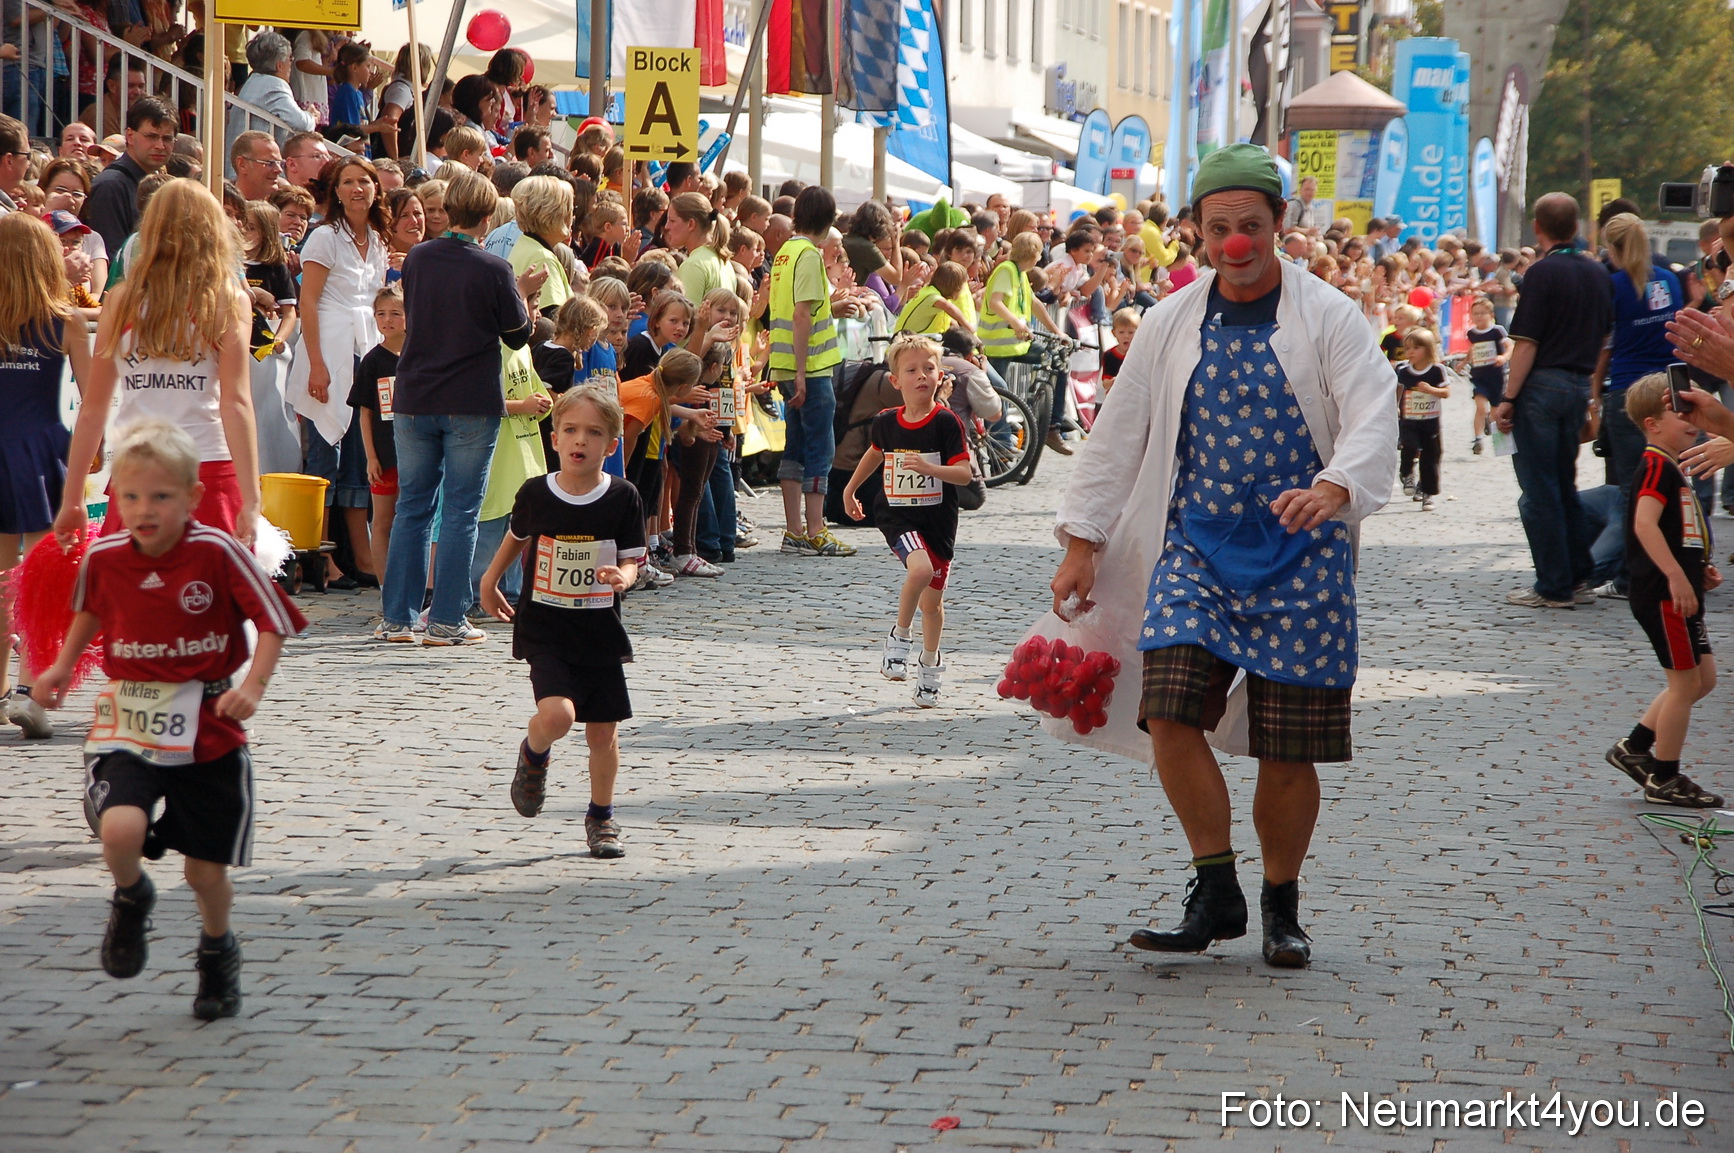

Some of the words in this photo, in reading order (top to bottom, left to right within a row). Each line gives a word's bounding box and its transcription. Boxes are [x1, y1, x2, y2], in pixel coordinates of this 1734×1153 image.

[634, 50, 691, 72] Block
[639, 81, 682, 136] A
[1300, 150, 1322, 173] 90
[125, 373, 208, 391] NEUMARKT
[1413, 400, 1437, 410] 7027
[896, 474, 936, 489] 7121
[556, 546, 591, 561] Fabian
[539, 560, 549, 572] K2
[556, 567, 607, 587] 708
[184, 594, 211, 608] FCN
[119, 679, 161, 700] Niklas
[121, 708, 187, 737] 7058
